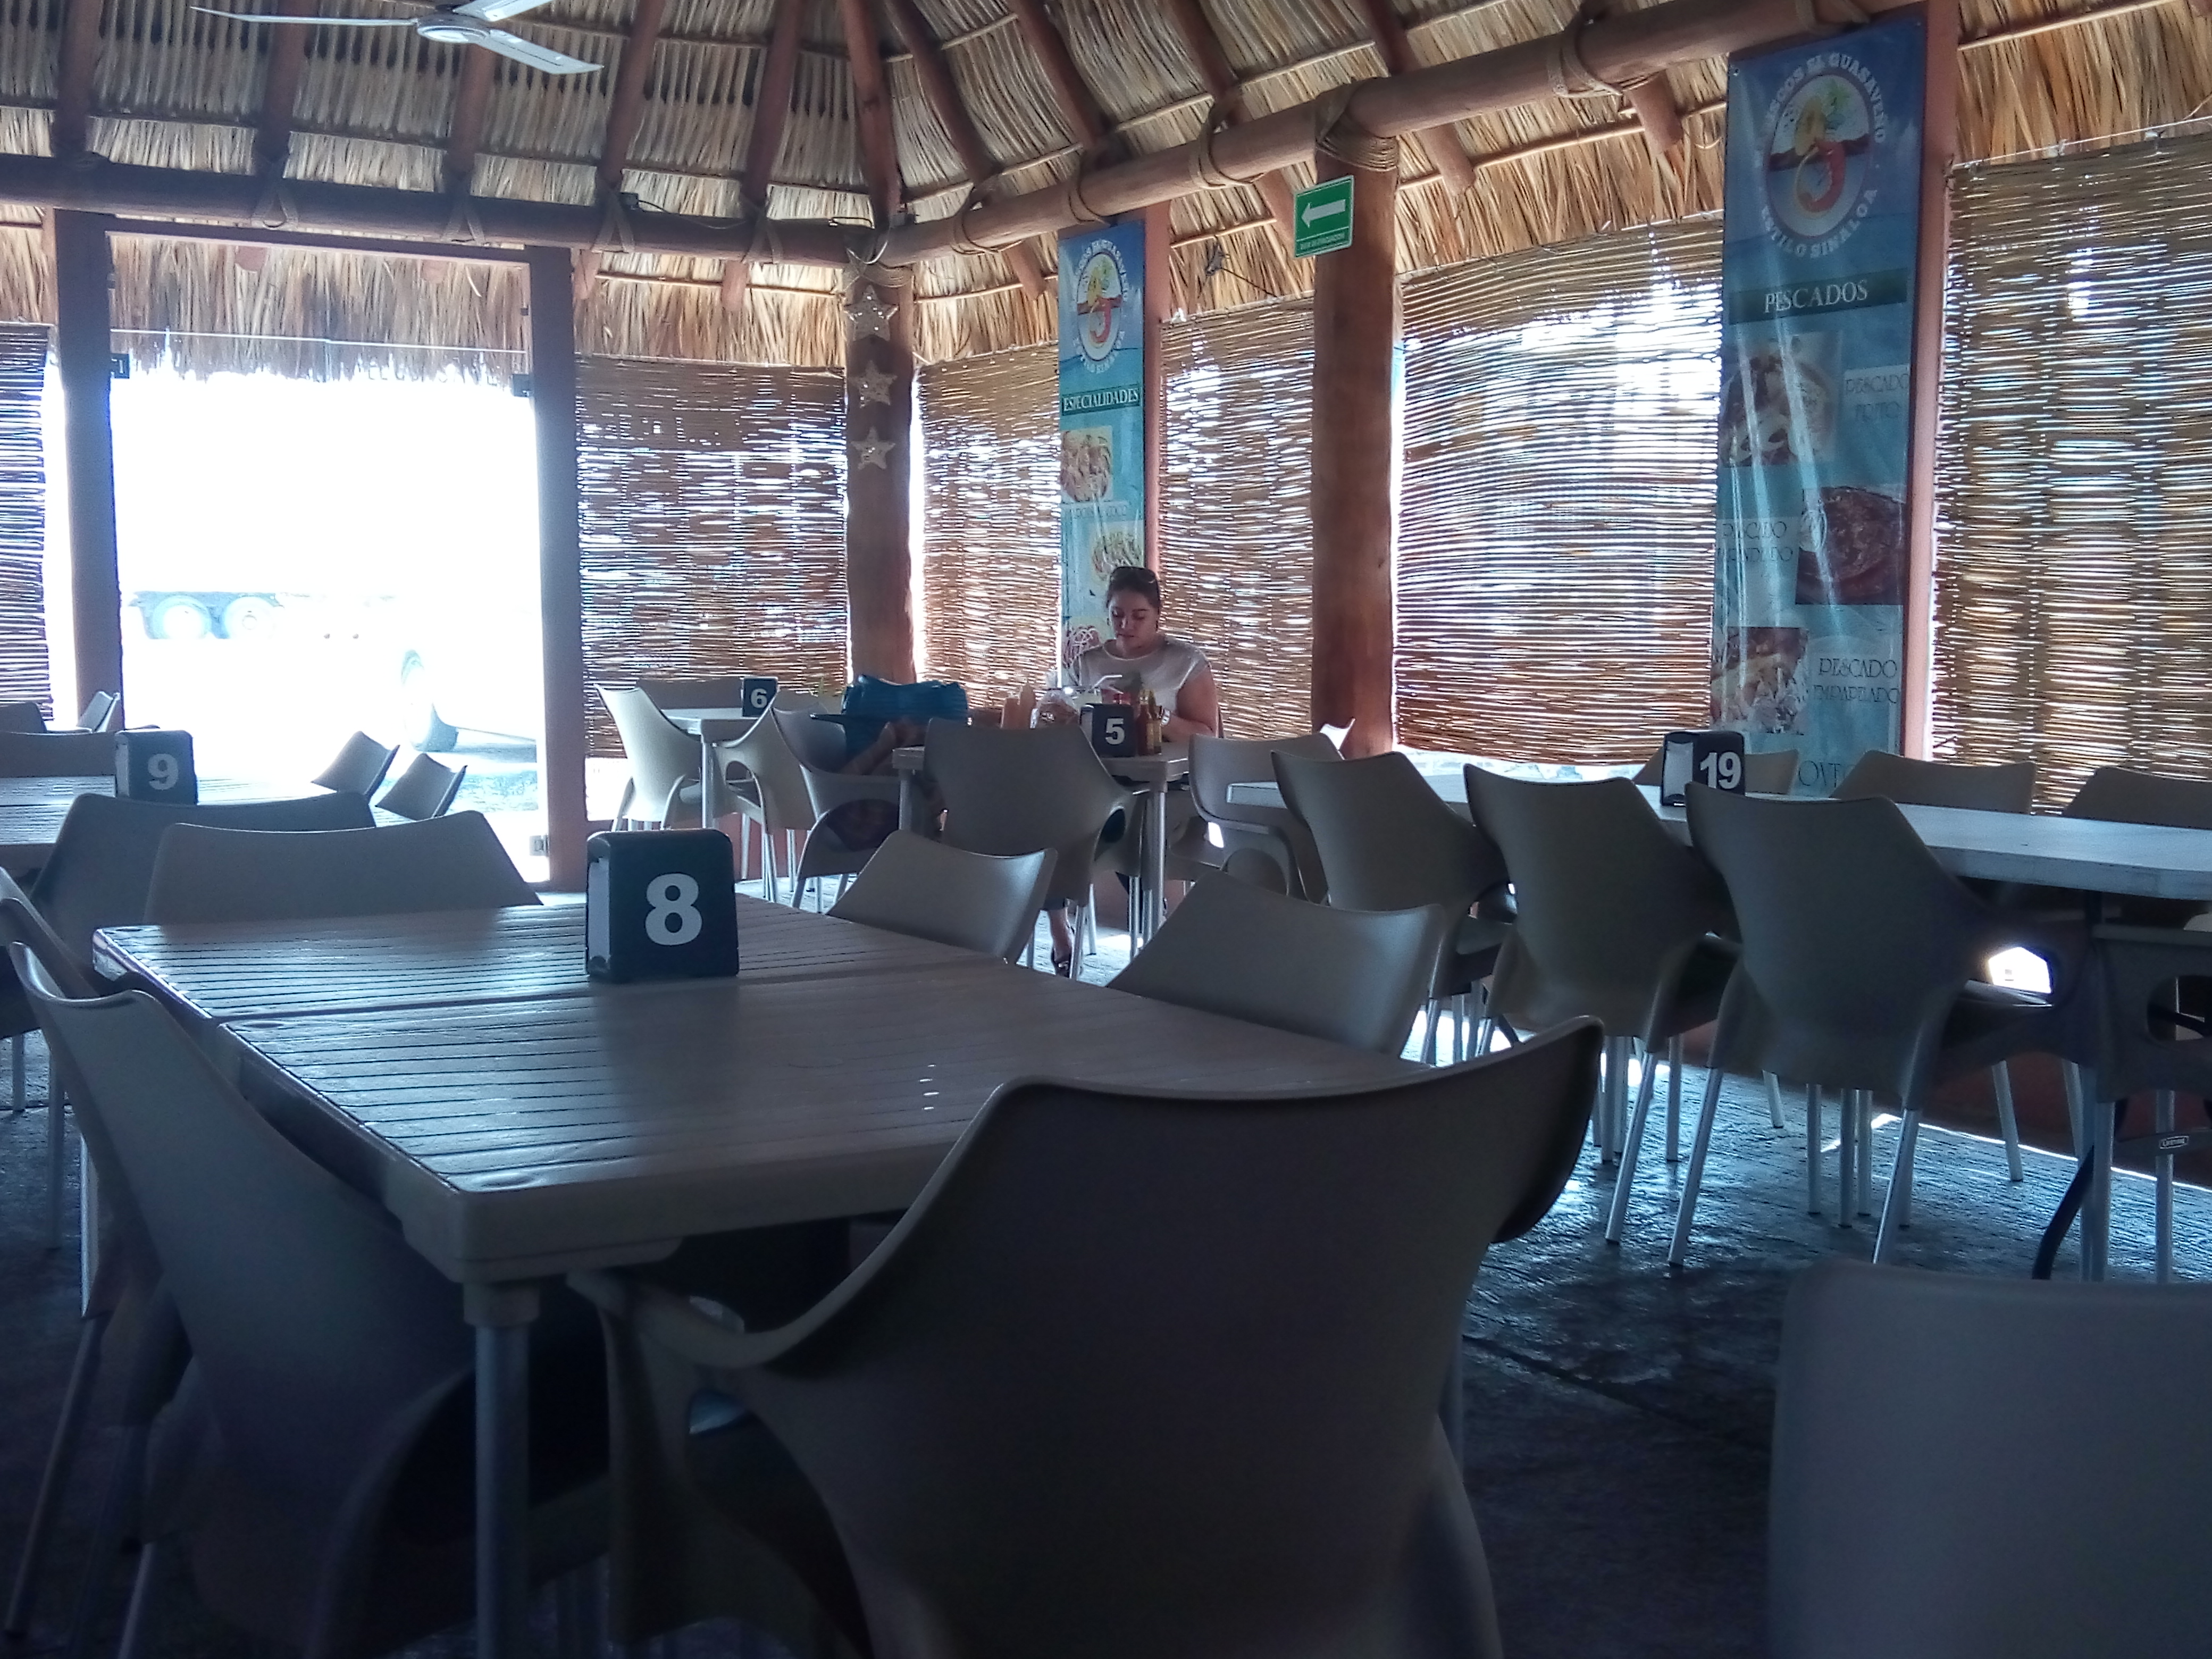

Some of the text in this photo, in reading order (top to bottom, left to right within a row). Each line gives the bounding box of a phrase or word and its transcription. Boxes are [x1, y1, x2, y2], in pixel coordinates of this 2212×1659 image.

[1764, 279, 1869, 314] PESCADOS
[1818, 657, 1897, 677] PESCADO
[751, 688, 767, 708] 6
[1105, 718, 1125, 745] 5
[147, 753, 179, 790] 9
[1700, 751, 1741, 789] 19
[645, 873, 702, 945] 8
